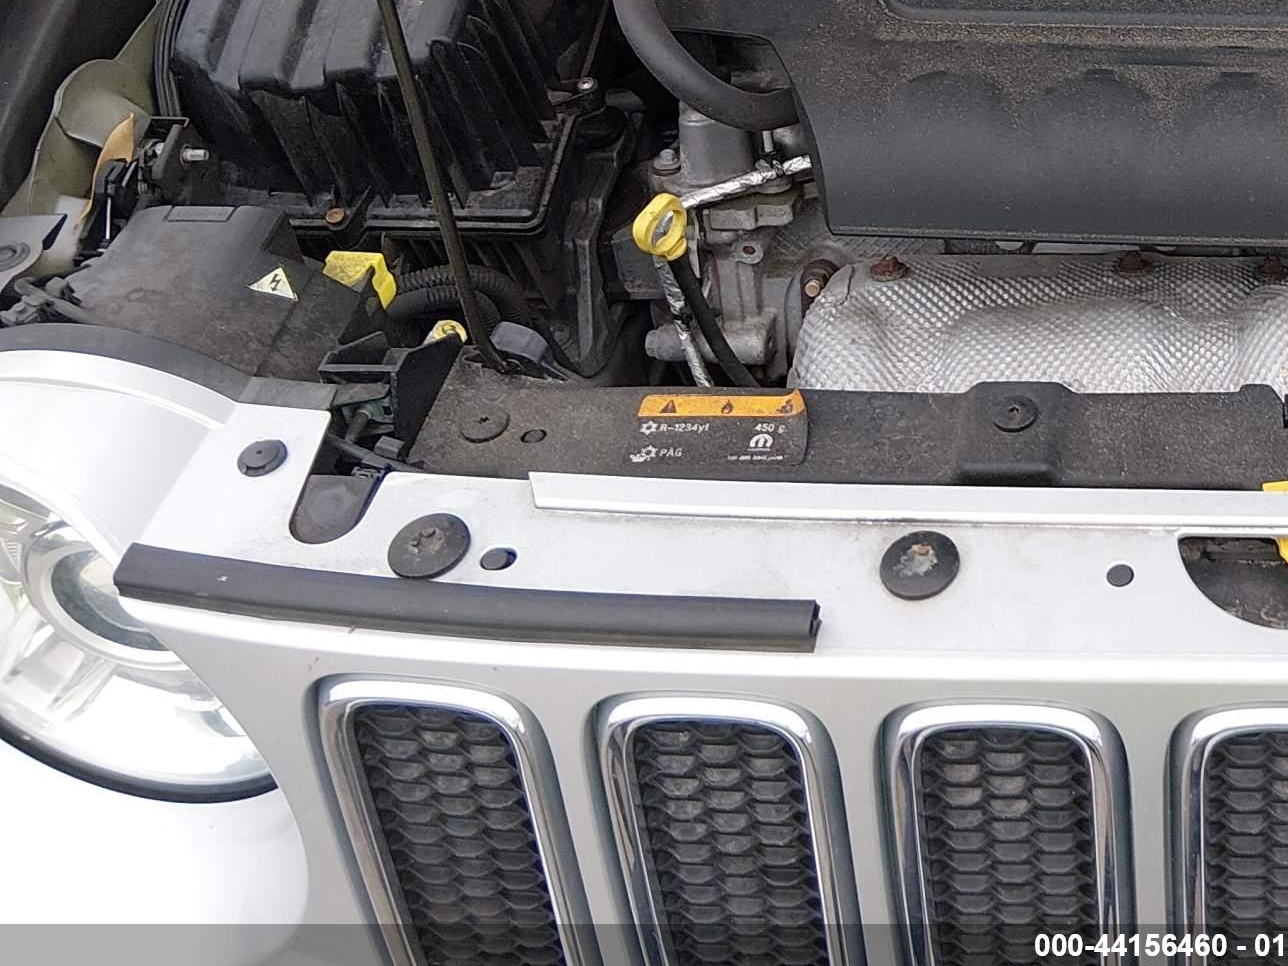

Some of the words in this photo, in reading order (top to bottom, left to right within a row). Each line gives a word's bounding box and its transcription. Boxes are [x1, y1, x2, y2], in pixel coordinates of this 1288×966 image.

[659, 422, 710, 433] R-1234yf
[754, 422, 776, 433] 450
[659, 447, 683, 458] PAG
